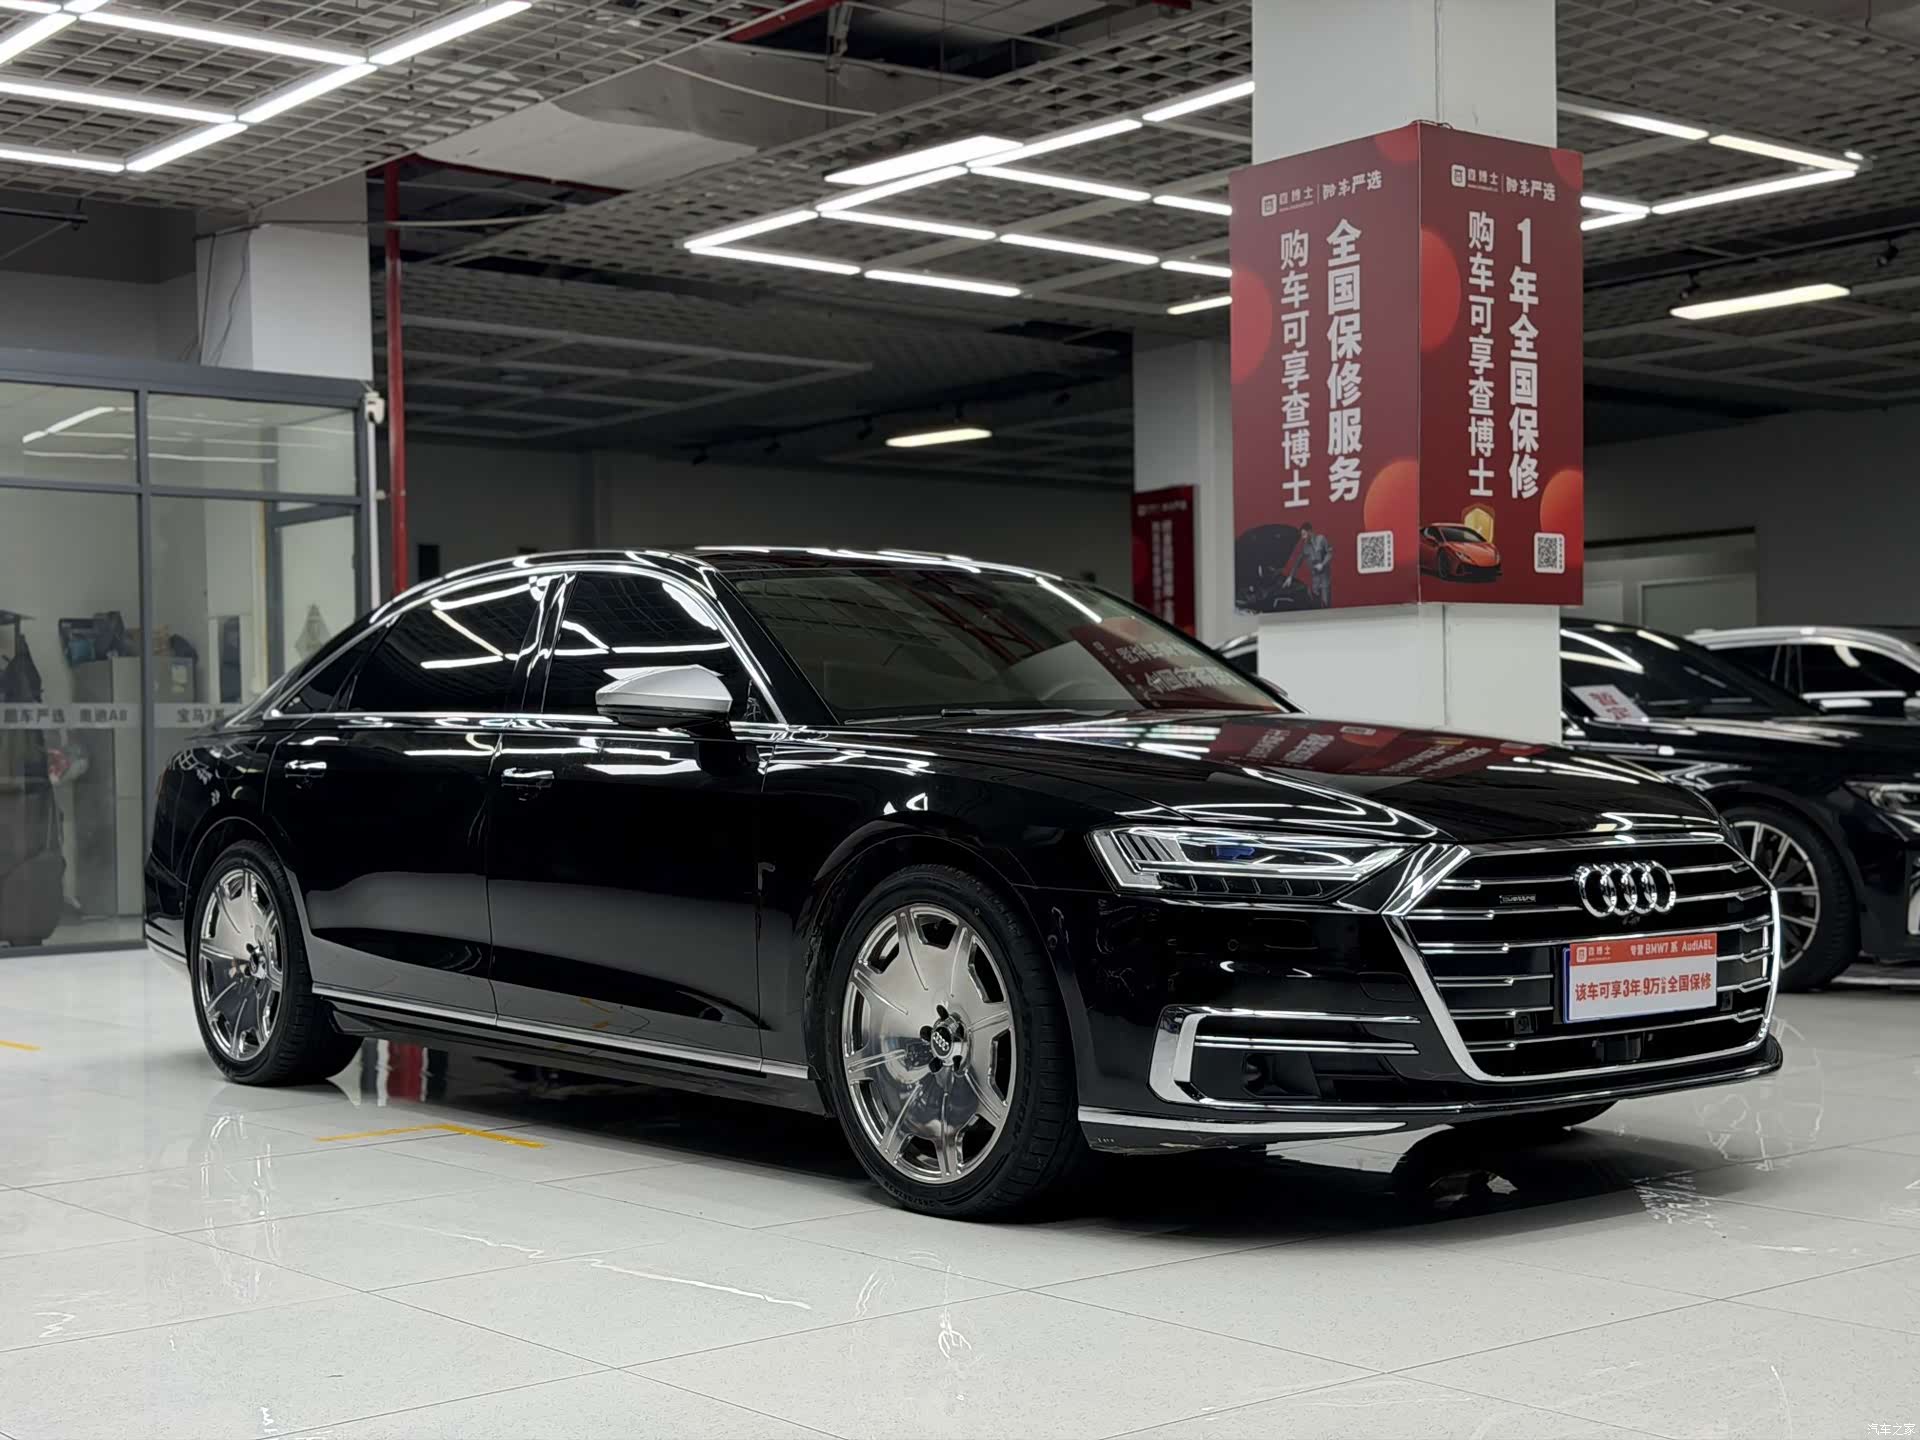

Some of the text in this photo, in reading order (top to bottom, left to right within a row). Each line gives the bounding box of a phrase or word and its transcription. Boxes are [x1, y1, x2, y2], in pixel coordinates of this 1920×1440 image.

[1280, 229, 1311, 509] 购车可享查博士
[1326, 218, 1363, 503] 全国保修服务
[1468, 211, 1495, 497] 购车可享查博士
[1509, 217, 1539, 500] 1年全国保修
